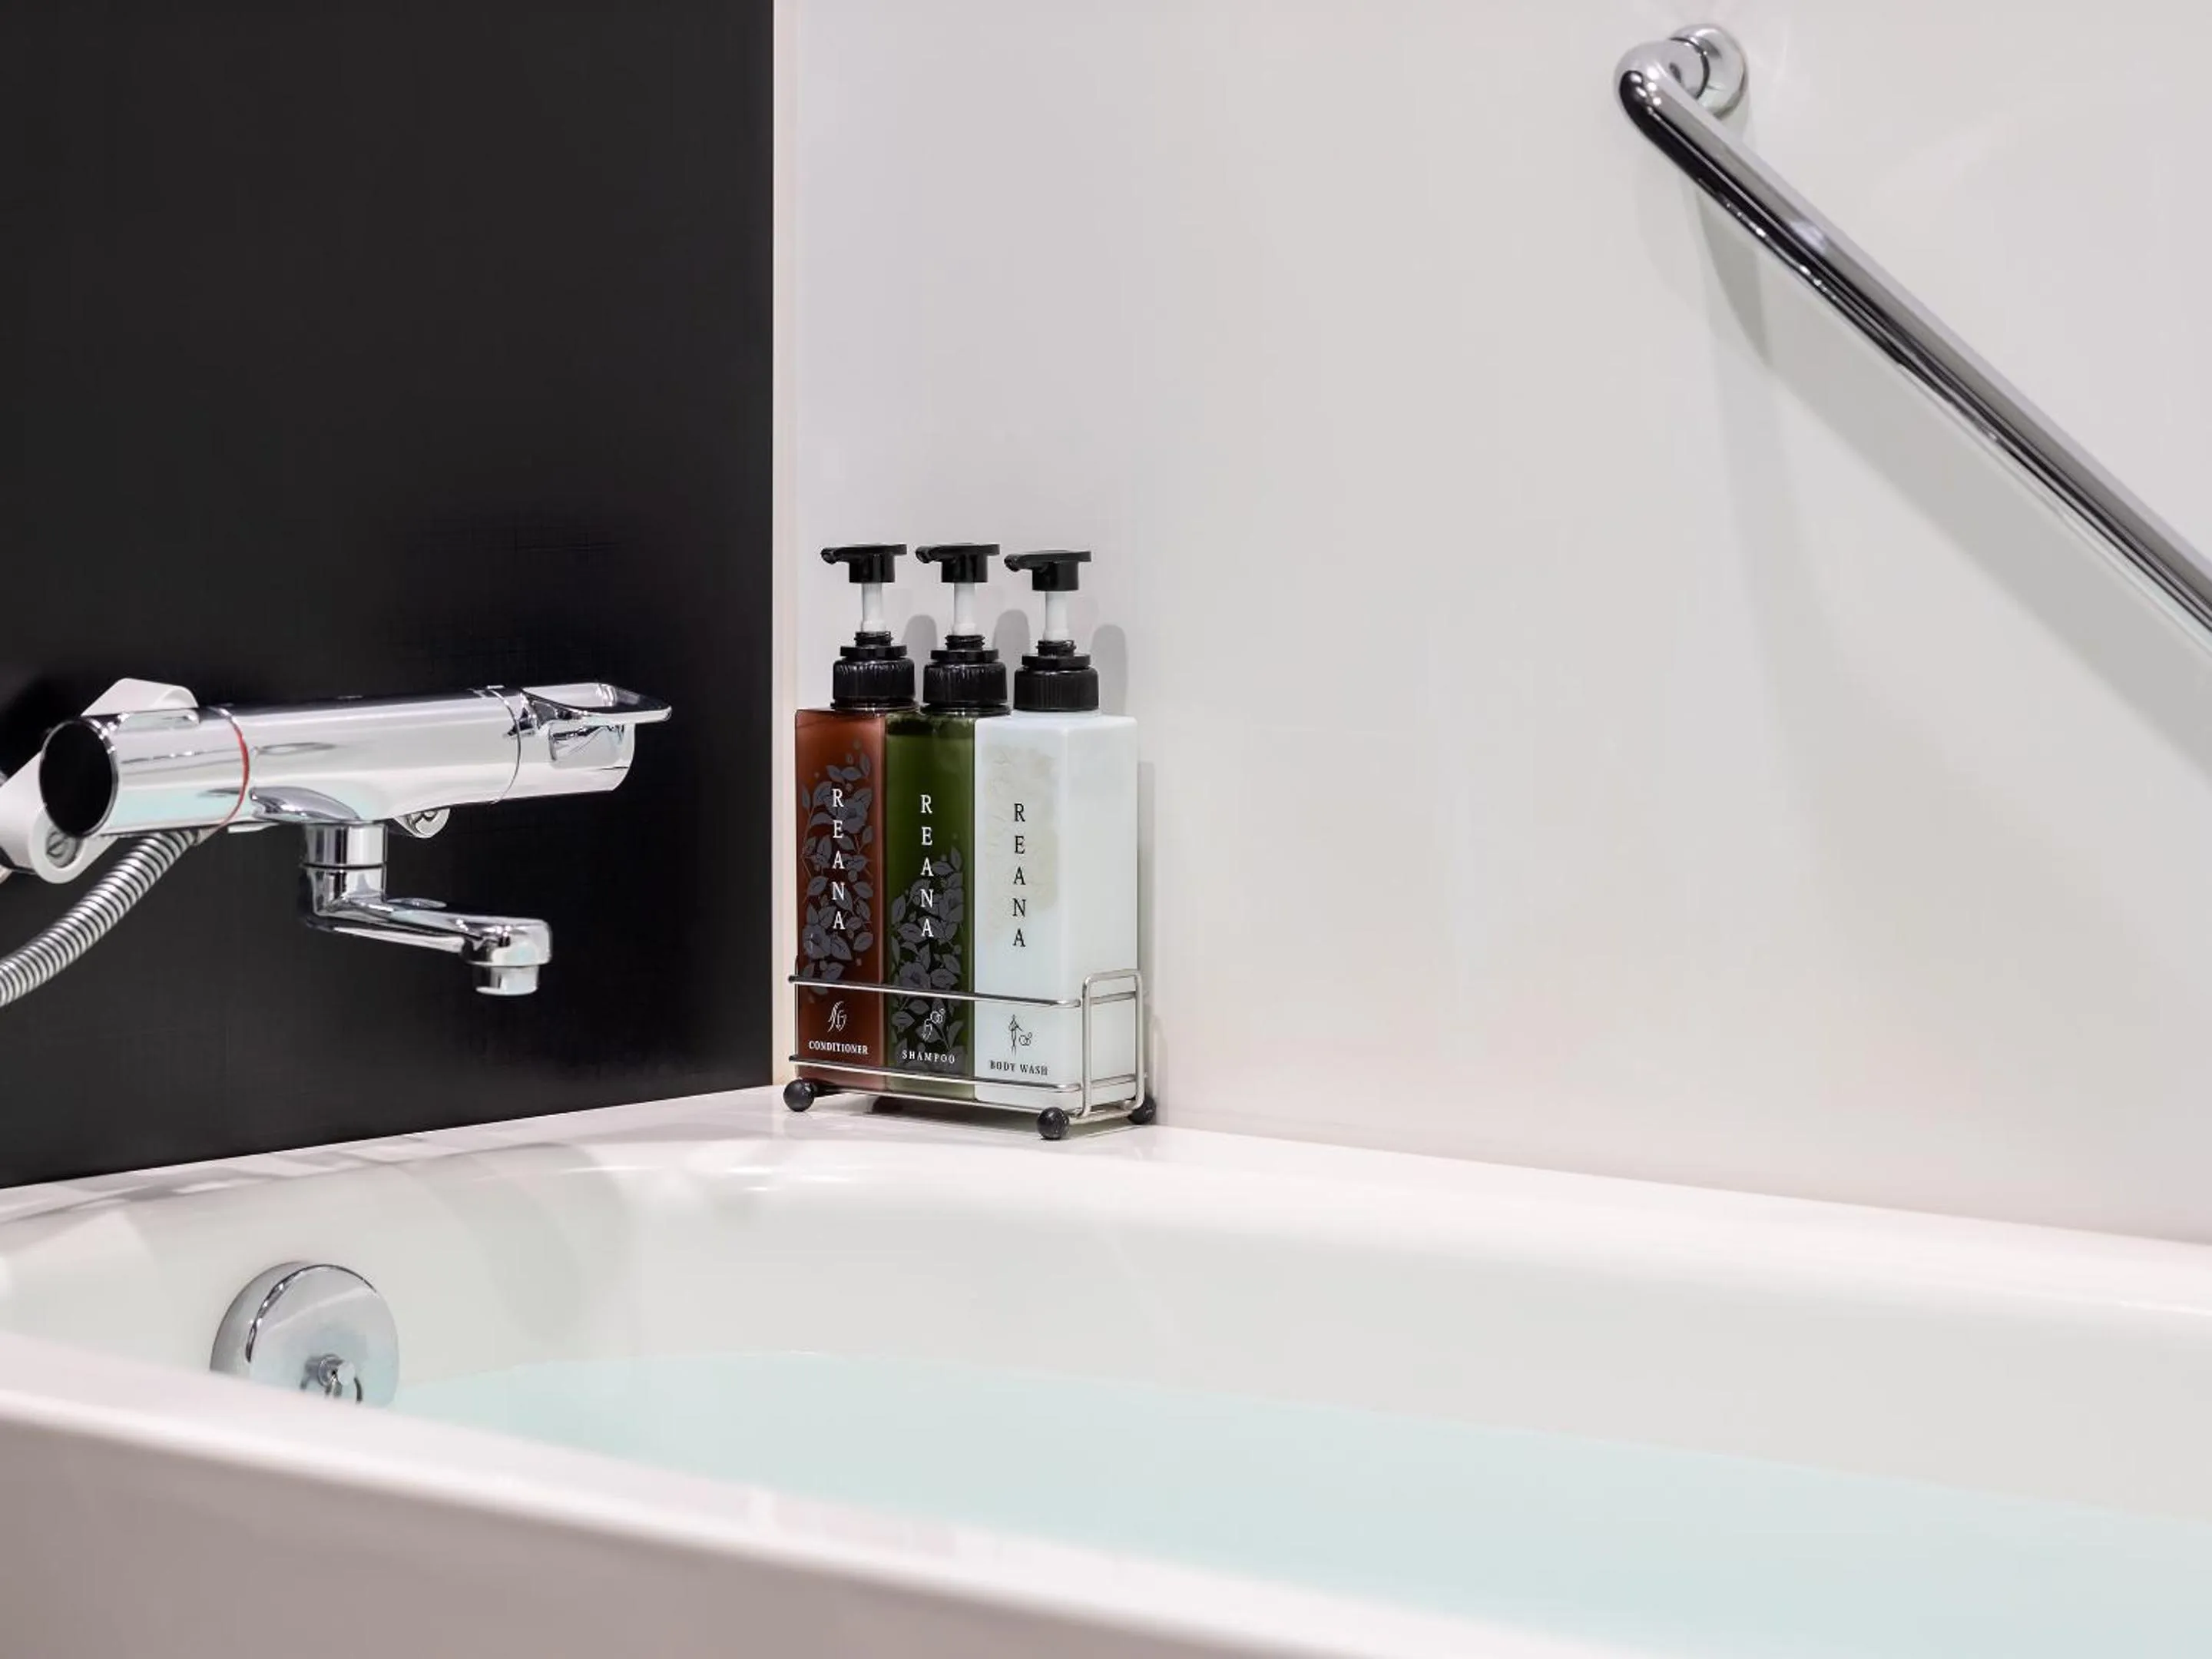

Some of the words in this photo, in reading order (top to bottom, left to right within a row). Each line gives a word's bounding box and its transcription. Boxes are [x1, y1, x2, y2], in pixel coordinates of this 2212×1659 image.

[831, 788, 846, 930] REANA
[919, 794, 934, 938] REANA
[1012, 803, 1026, 947] REANA
[808, 1040, 869, 1055] CONDITIONER
[902, 1049, 956, 1065] SHAMPOO
[988, 1060, 1016, 1073] BODY
[1020, 1063, 1048, 1076] WASH
